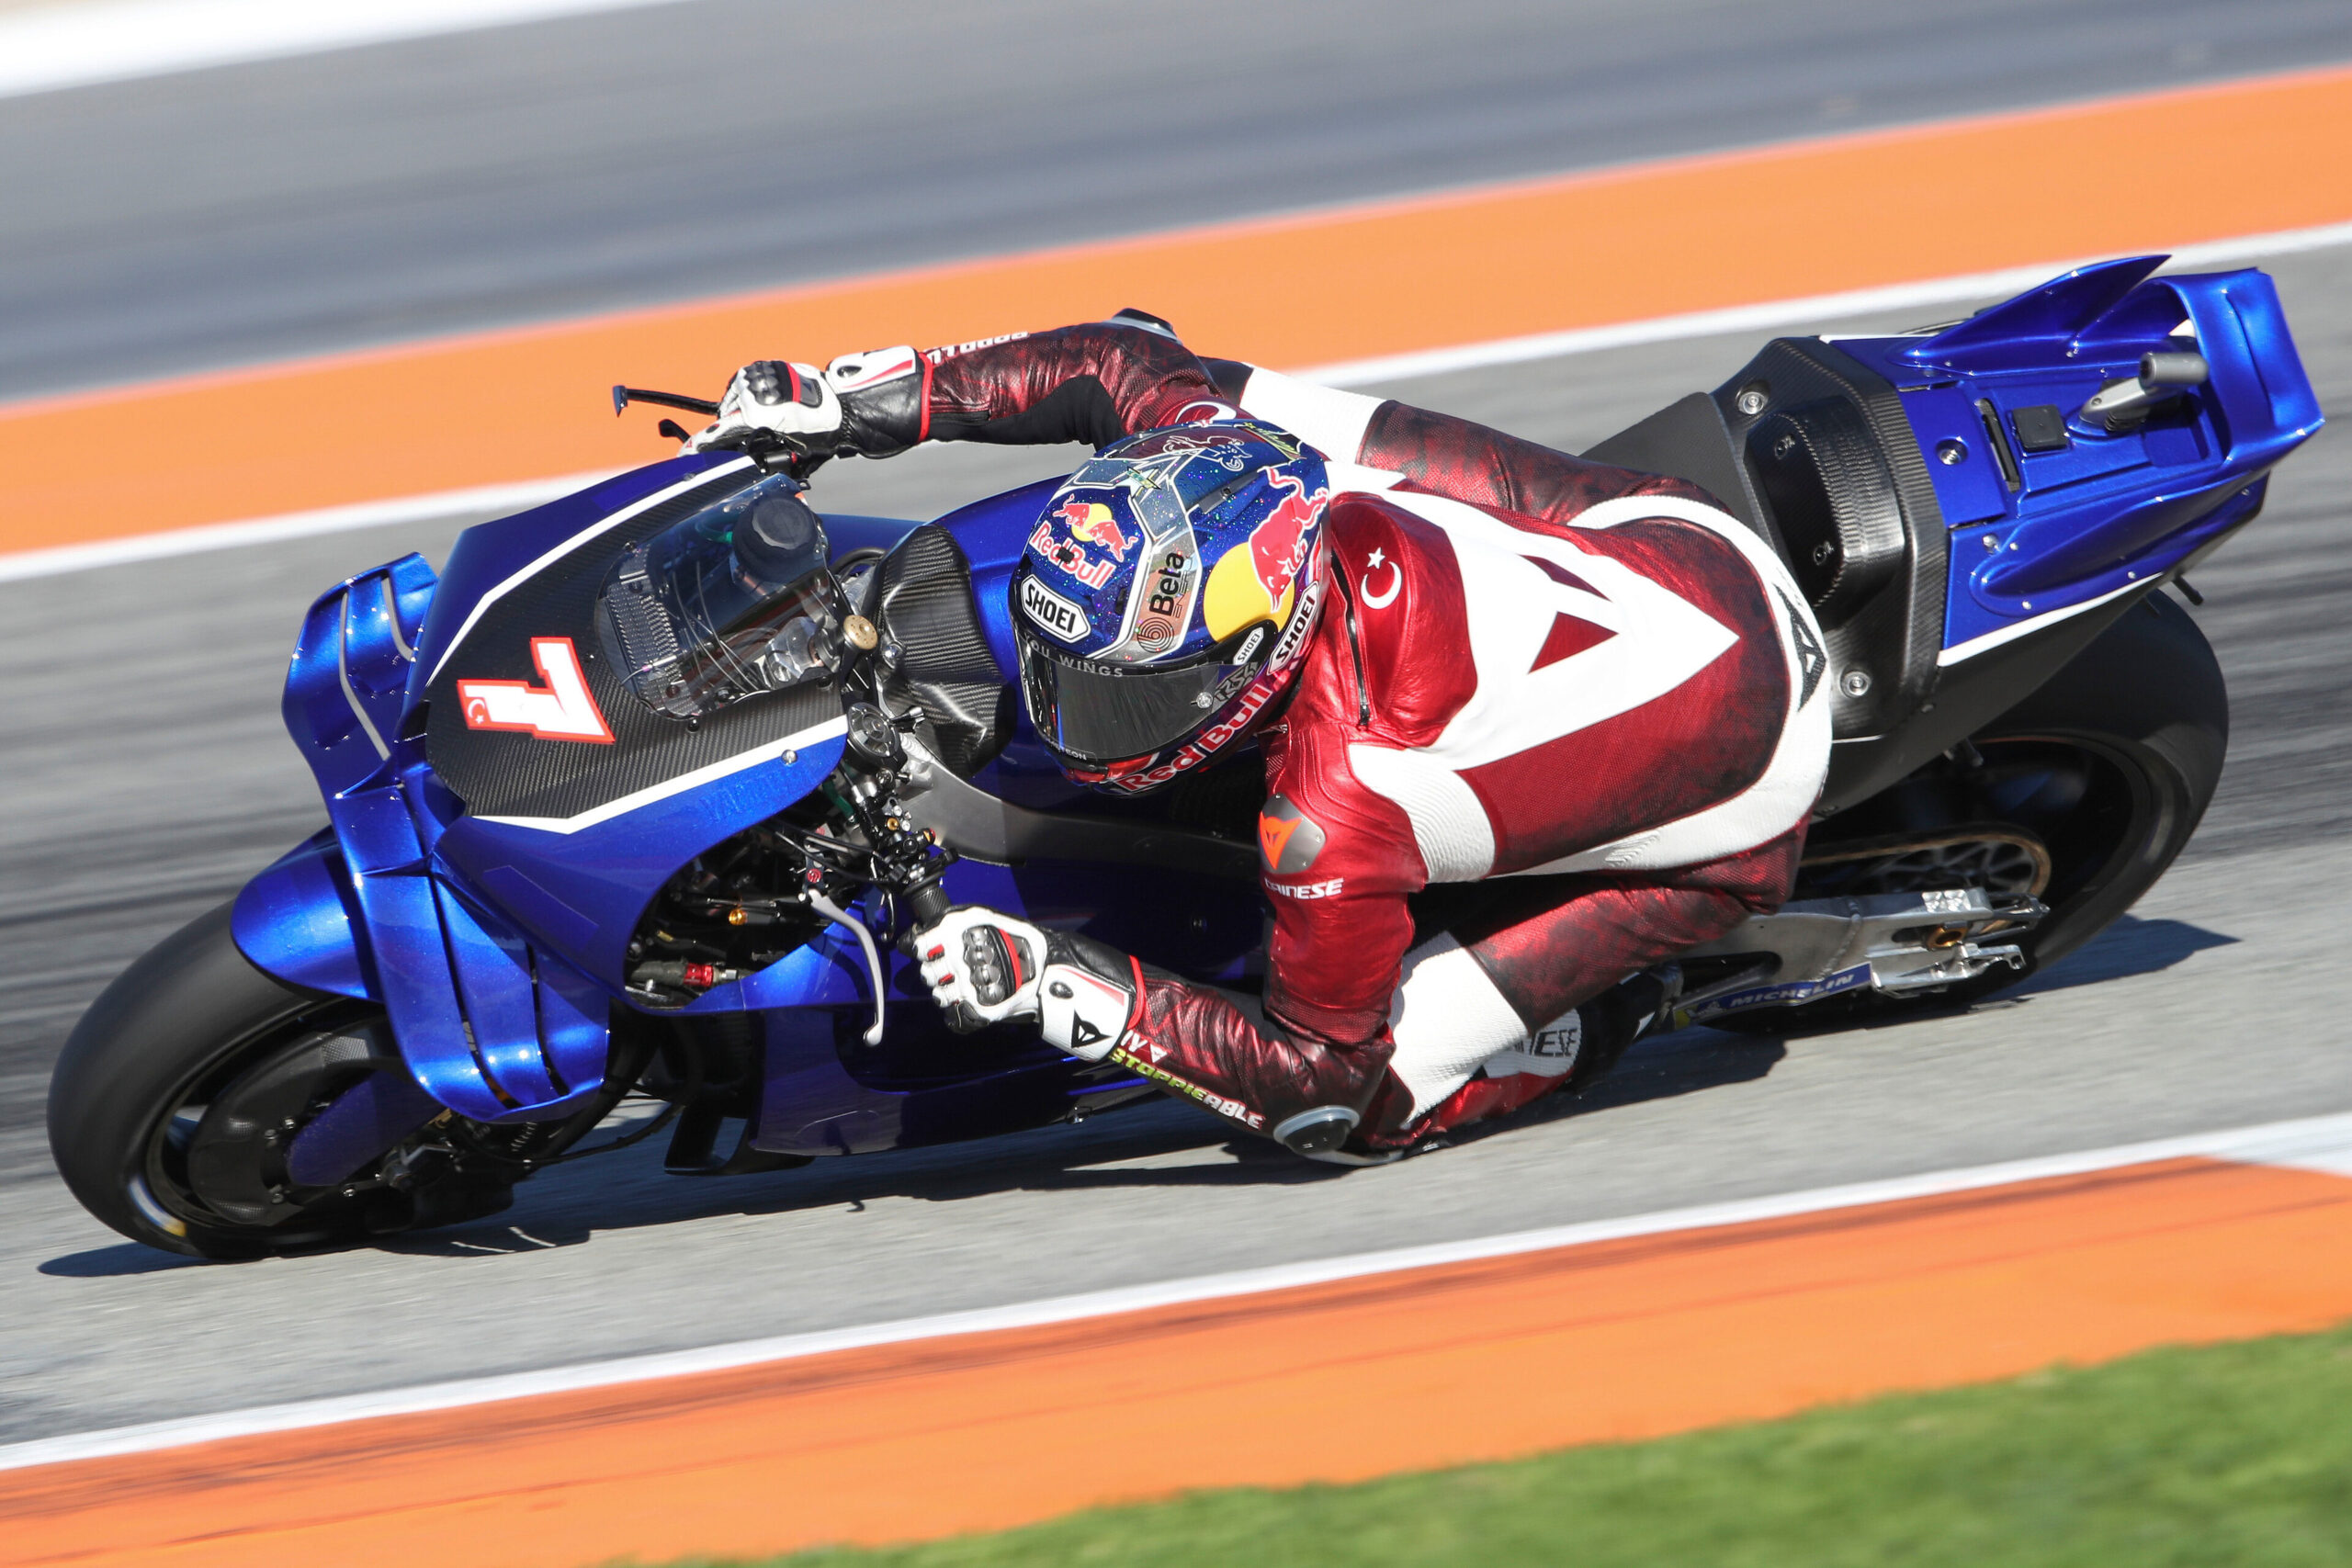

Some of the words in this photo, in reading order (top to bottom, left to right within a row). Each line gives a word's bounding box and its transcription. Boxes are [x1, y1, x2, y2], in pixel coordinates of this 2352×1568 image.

[1025, 583, 1077, 634] SHOEI
[1149, 552, 1184, 616] Beta
[1238, 633, 1261, 662] SHOEI
[1276, 595, 1316, 662] SHOEI
[1059, 654, 1124, 678] WINGS
[1115, 745, 1206, 792] Red
[1194, 683, 1274, 753] Bull
[1730, 974, 1854, 1008] MICHELIN
